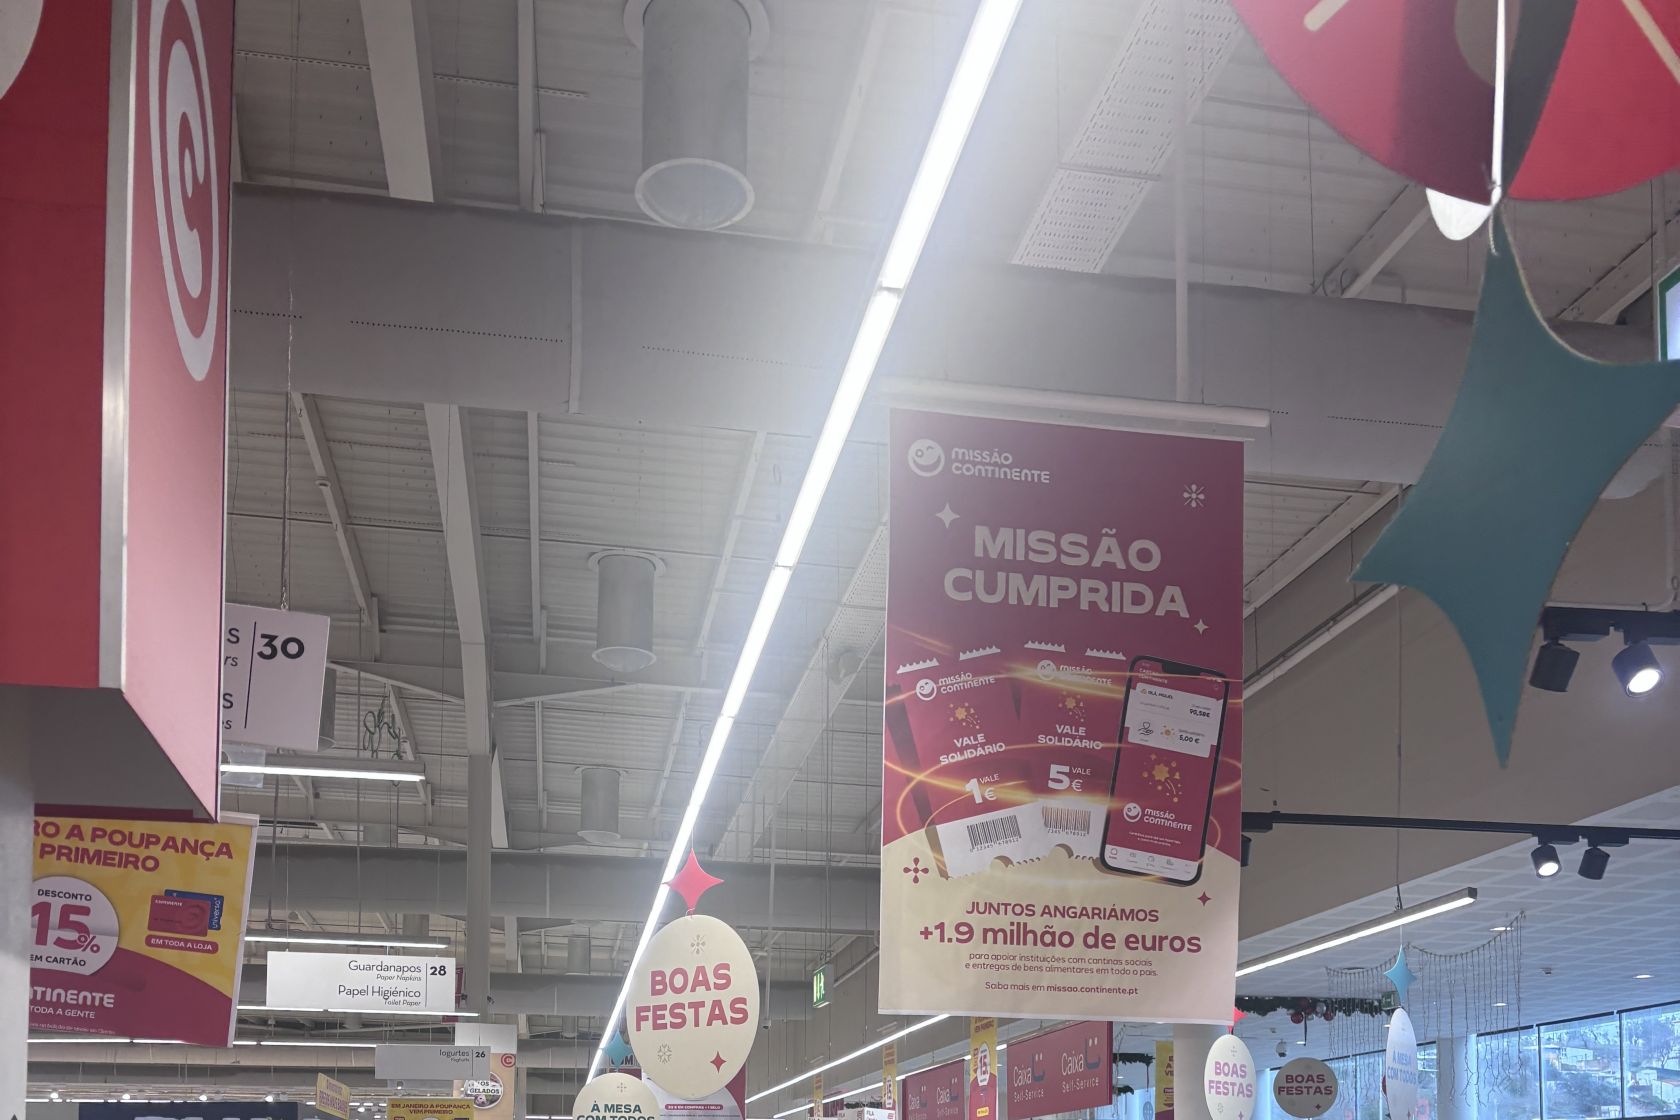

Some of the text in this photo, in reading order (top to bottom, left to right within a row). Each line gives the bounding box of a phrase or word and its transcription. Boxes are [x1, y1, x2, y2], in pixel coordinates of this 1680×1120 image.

[951, 447, 1012, 465] MISSÃO
[951, 463, 1050, 484] CONTINENTE
[974, 525, 1162, 572] MISSÃO
[943, 567, 1190, 618] CUMPRIDA
[257, 633, 305, 660] 30
[938, 672, 973, 686] MISSÃO
[941, 675, 996, 694] CONTINENTE
[1056, 724, 1087, 736] VALE
[953, 733, 986, 748] VALE
[1037, 734, 1103, 750] SOLIDÁRIO
[939, 742, 1006, 765] SOLIDÁRIO
[1048, 764, 1091, 790] 5 VALE
[1071, 779, 1083, 792] €
[965, 773, 1000, 804] 1 VALE
[984, 787, 997, 801] €
[1144, 808, 1175, 820] MISSÃO
[1143, 814, 1193, 832] CONTINENTE
[65, 824, 233, 861] A POUPANÇA
[39, 843, 160, 872] PRIMEIRO
[37, 888, 92, 901] DESCONTO
[965, 901, 1160, 922] JUNTOS ANGARIÁMOS
[163, 939, 186, 948] TODA
[194, 942, 213, 951] LOJA
[920, 921, 1202, 953] +1.9 milhão de euros
[45, 954, 86, 966] CARTÃO
[348, 959, 447, 977] Guardanapos 28
[969, 952, 990, 962] para
[990, 952, 1017, 963] apoiar
[1019, 953, 1066, 964] instituições
[1087, 956, 1123, 965] cantinas
[1124, 958, 1152, 967] sociais
[972, 962, 1010, 972] entregas
[1011, 963, 1022, 971] de
[1023, 963, 1043, 973] bens
[1045, 964, 1093, 974] alimentares
[1095, 967, 1109, 975] em
[1110, 966, 1131, 976] todo
[376, 973, 422, 983] Paper Napkins
[650, 962, 731, 996] BOAS
[338, 984, 422, 1001] Papel Higiénico
[985, 981, 1139, 996] Saiba mais em missao.continente.pt
[403, 998, 422, 1008] Paper
[56, 1008, 63, 1016] A
[65, 1009, 95, 1019] GENTE
[635, 997, 749, 1032] FESTAS
[439, 1049, 469, 1059] Iogurtes
[1061, 1049, 1084, 1076] Caixa
[1013, 1062, 1032, 1087] Caixa
[1214, 1061, 1247, 1078] BOAS
[1062, 1077, 1100, 1094] Self-Service
[1285, 1074, 1325, 1084] BOAS
[1014, 1088, 1044, 1103] Self-Service
[1208, 1080, 1253, 1098] FESTAS
[1278, 1086, 1333, 1096] FESTAS
[604, 1104, 642, 1114] MESA
